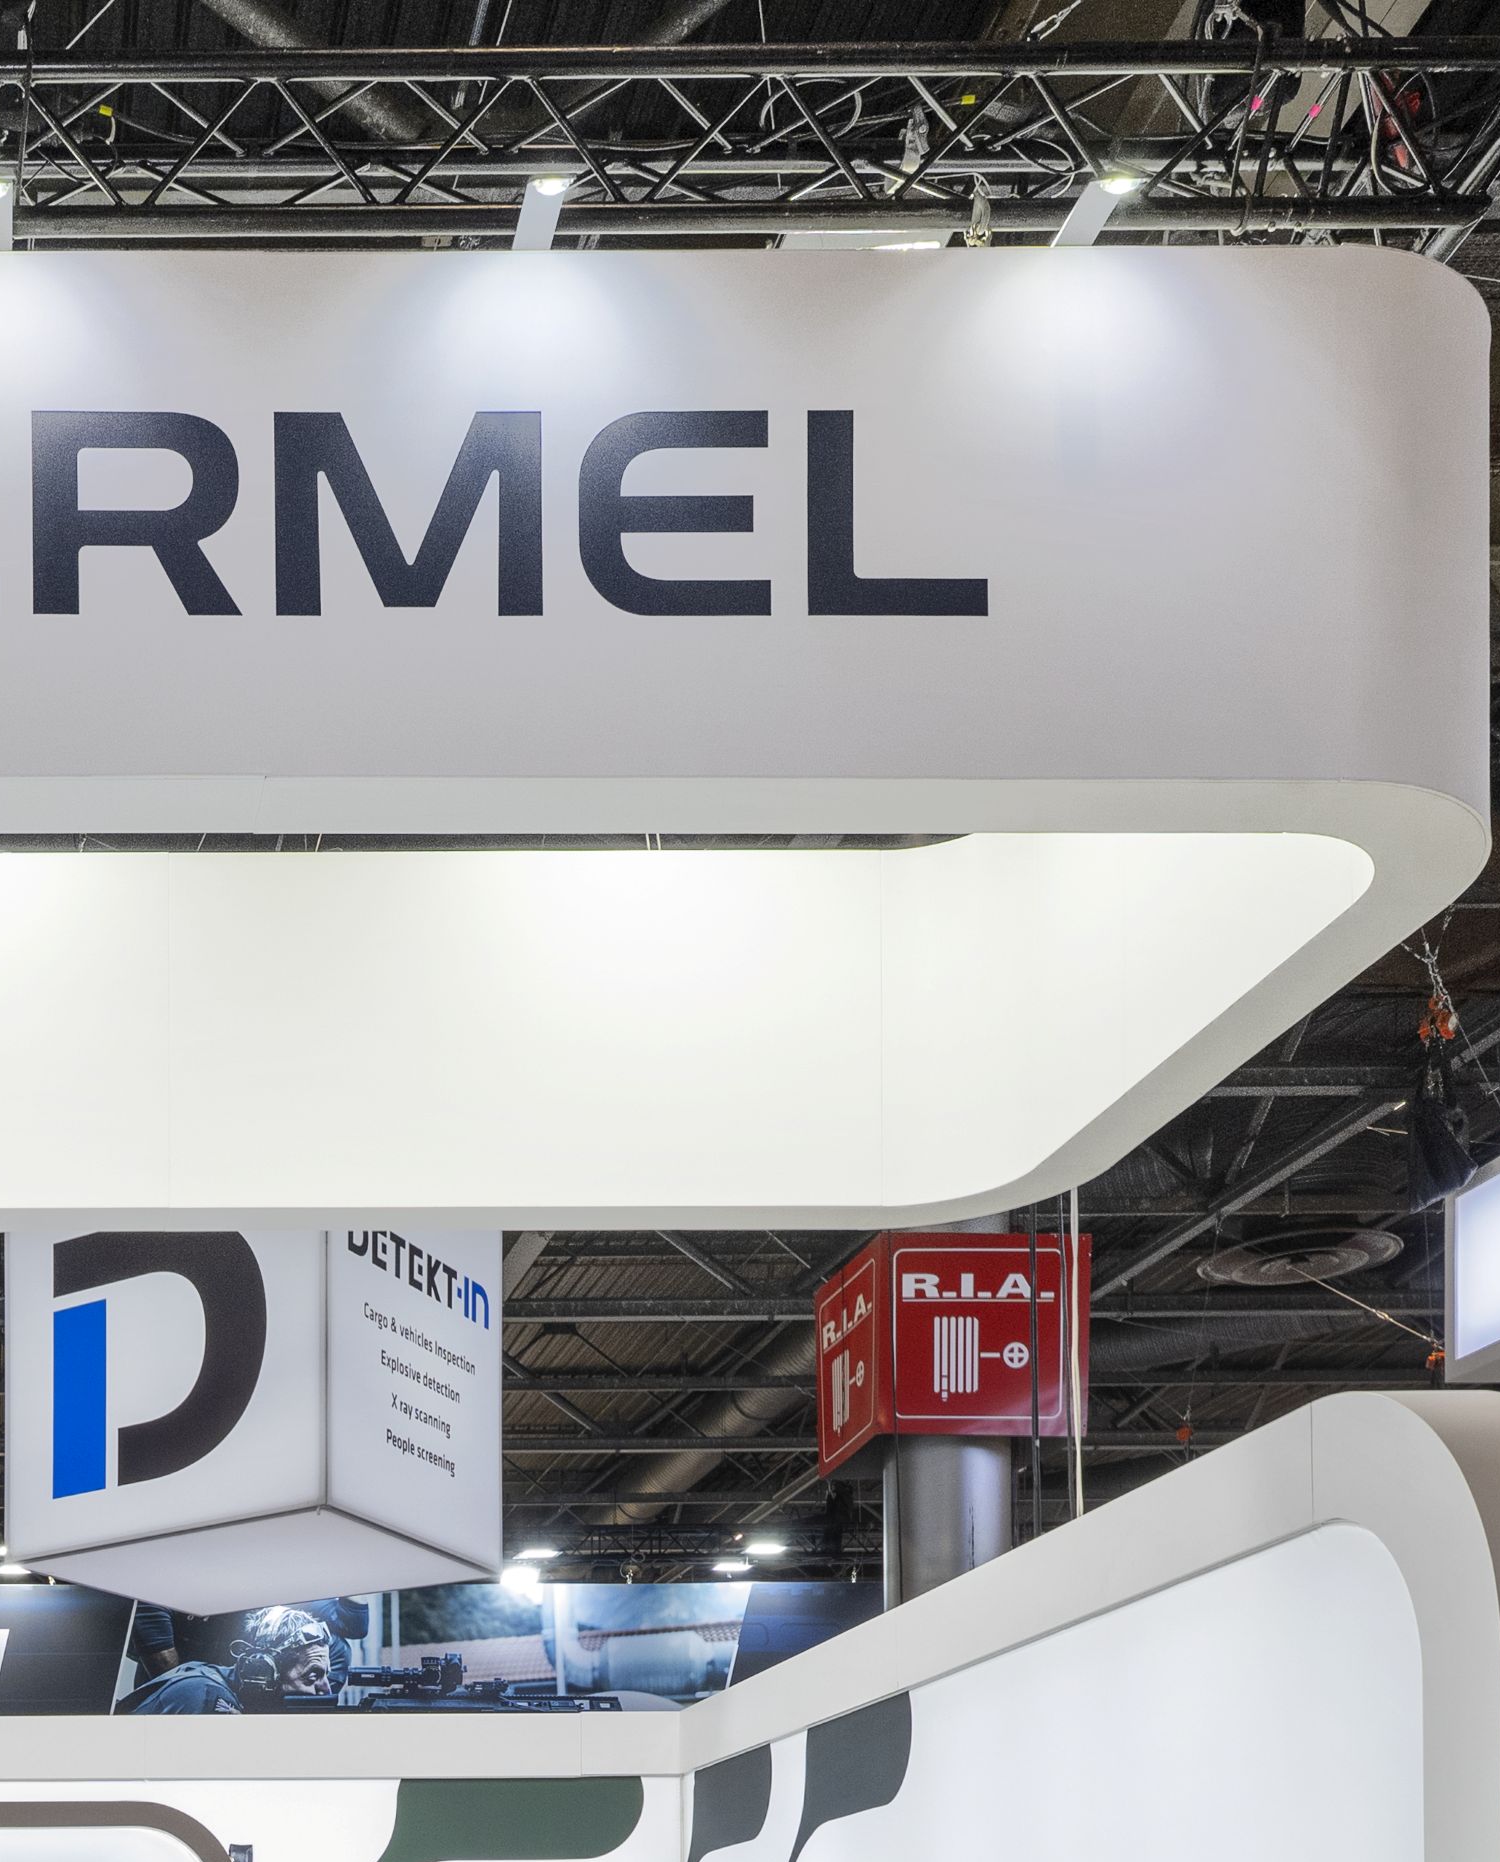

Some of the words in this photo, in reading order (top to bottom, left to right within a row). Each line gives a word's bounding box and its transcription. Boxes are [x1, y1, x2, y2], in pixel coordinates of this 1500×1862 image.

[902, 1273, 1055, 1298] R.I.A.
[364, 1302, 388, 1330] Cargo
[391, 1316, 397, 1334] &
[400, 1324, 433, 1353] vehicles
[434, 1341, 476, 1376] Inspection
[822, 1293, 872, 1350] R.I.A.
[381, 1350, 421, 1384] Explosive
[423, 1372, 460, 1404] detection
[391, 1392, 398, 1409] X
[400, 1401, 413, 1420] ray
[415, 1407, 451, 1439] scanning
[386, 1429, 415, 1455] People
[417, 1446, 455, 1478] screening
